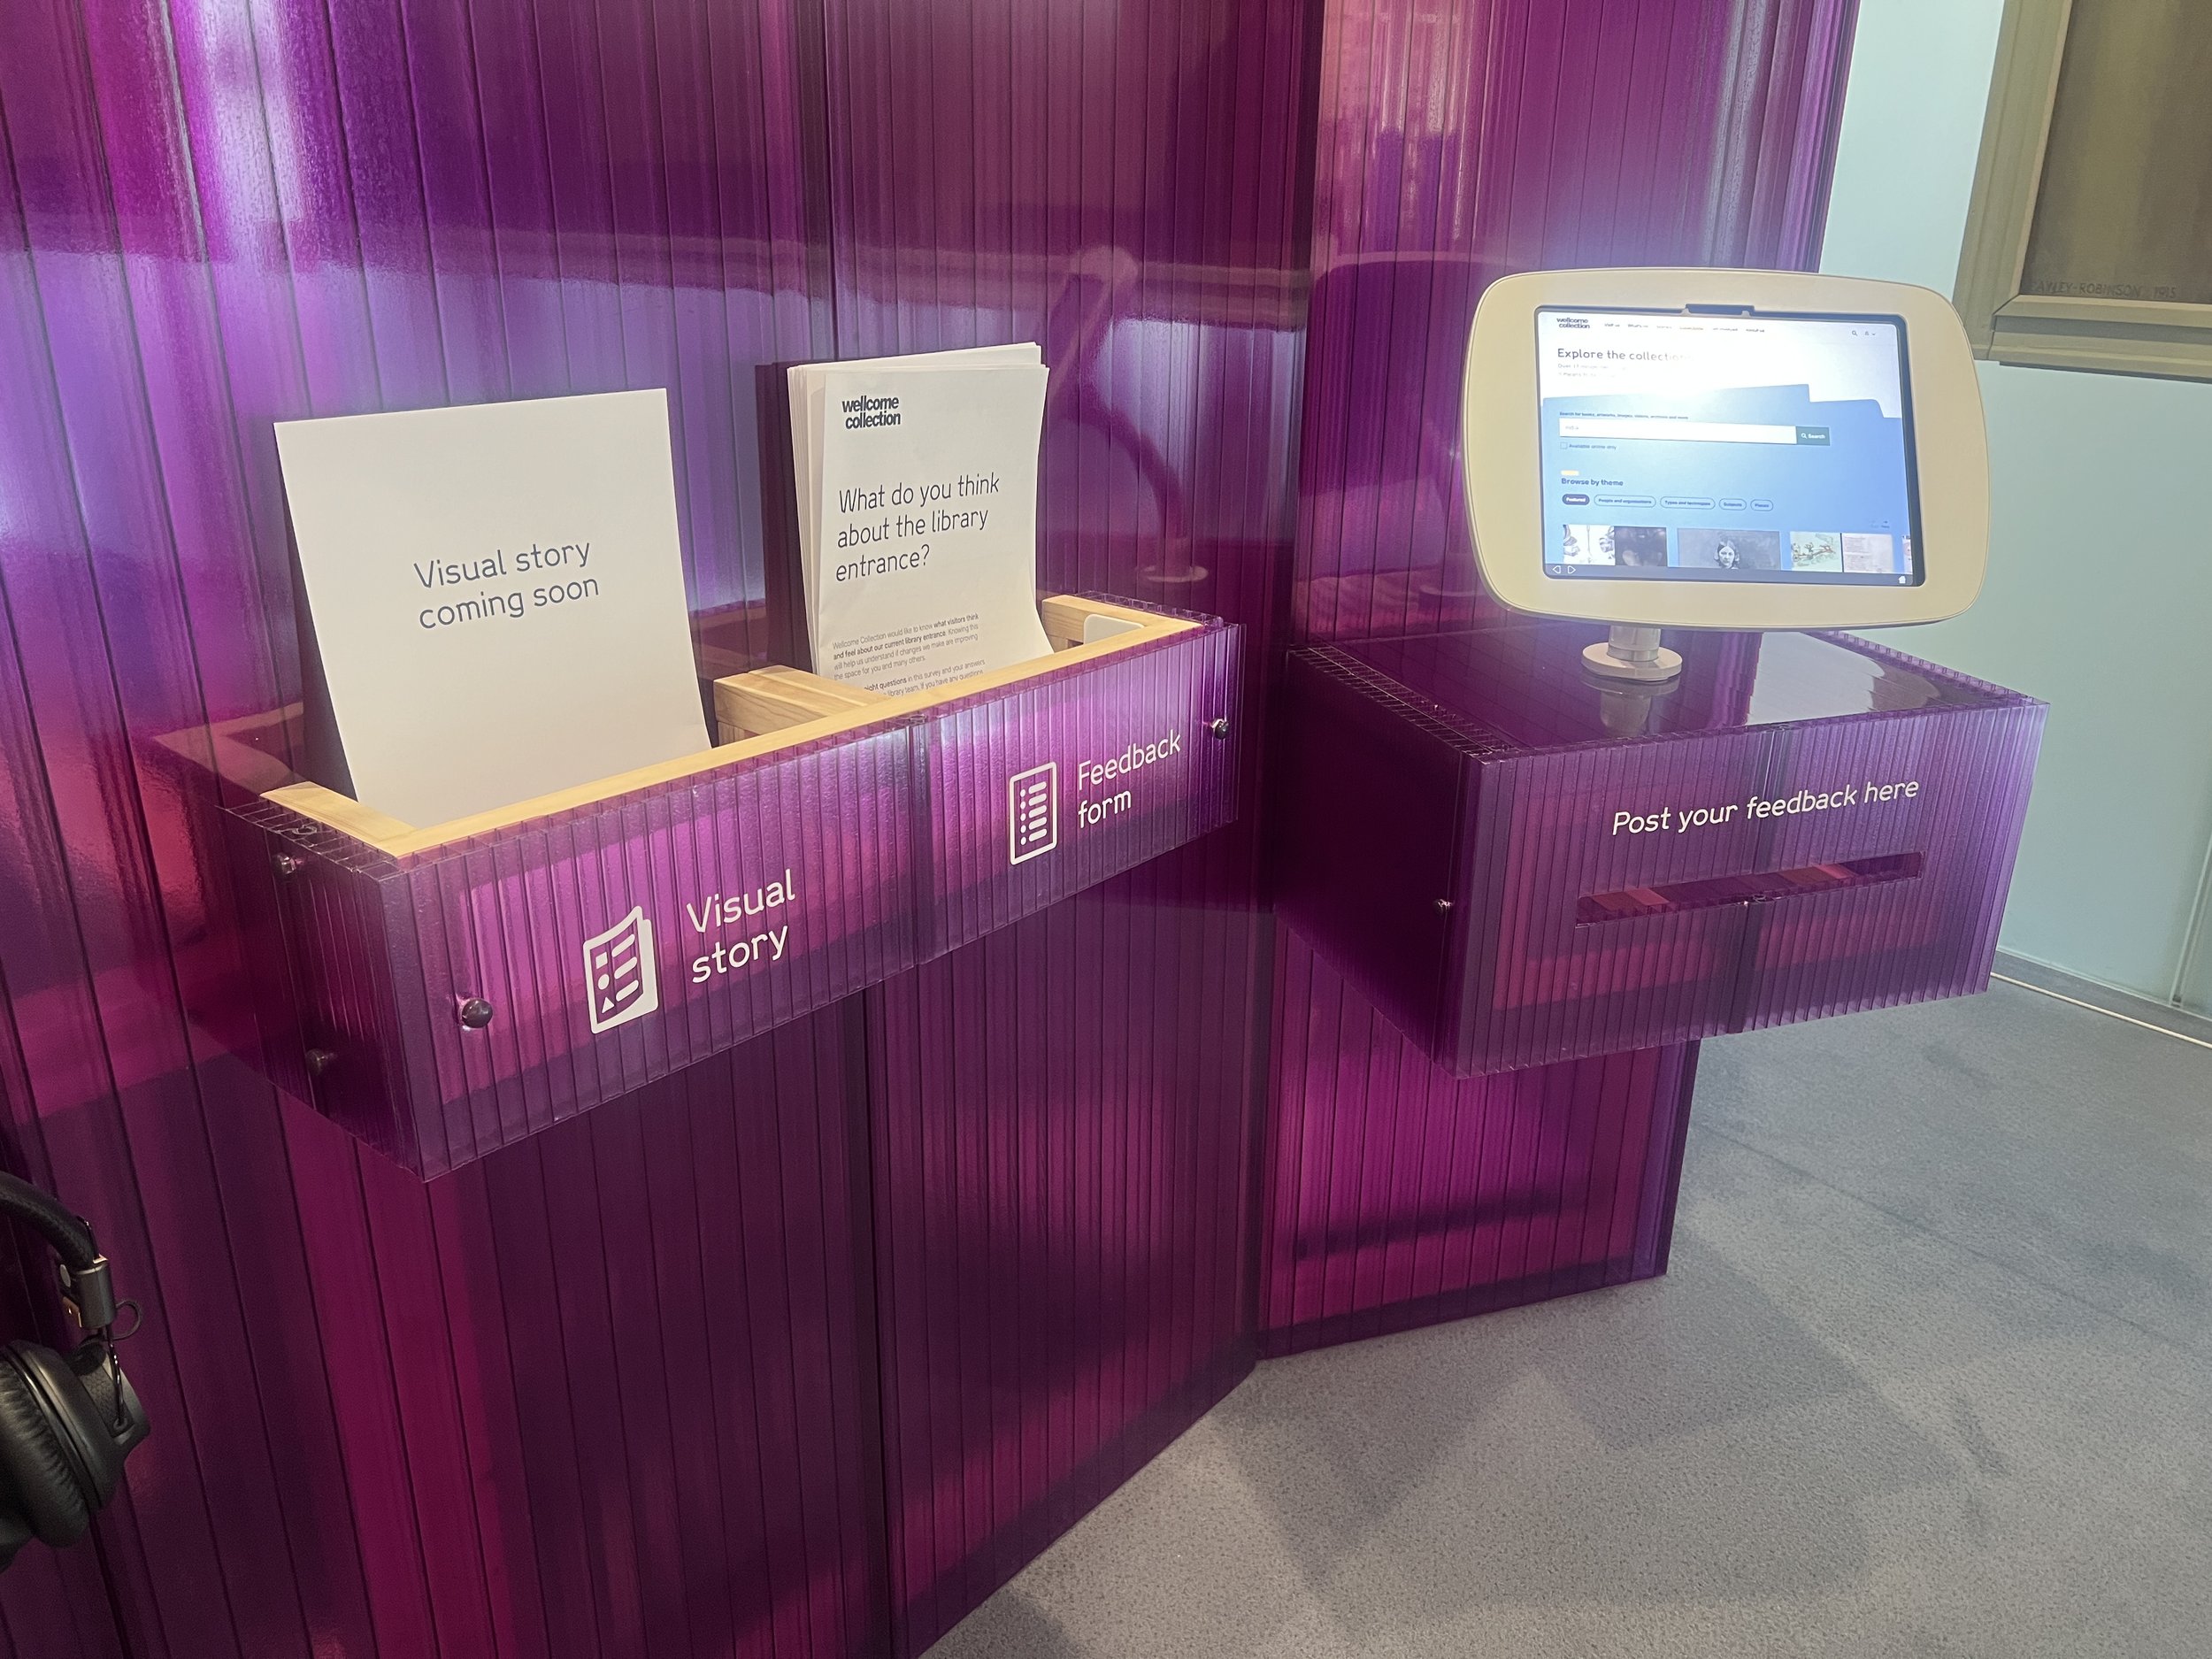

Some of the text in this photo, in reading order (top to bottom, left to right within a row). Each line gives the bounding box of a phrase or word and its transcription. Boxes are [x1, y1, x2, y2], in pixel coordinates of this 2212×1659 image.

[1557, 348, 1603, 361] Explore
[1607, 349, 1626, 361] the
[841, 396, 900, 412] wellcome
[845, 411, 902, 430] collection
[839, 472, 1000, 513] What do you think
[837, 509, 989, 549] about the library
[413, 542, 590, 588] Visual story
[835, 543, 930, 582] entrance?
[419, 578, 599, 629] coming soon
[833, 639, 859, 650] Wellcome
[860, 633, 887, 644] Collection
[887, 627, 903, 638] would
[947, 615, 966, 626] visitors
[966, 612, 979, 621] think
[833, 651, 844, 660] and
[845, 649, 856, 657] feel
[857, 645, 873, 656] about
[884, 639, 904, 649] current
[905, 635, 922, 645] library
[948, 625, 969, 635] Knowing
[843, 659, 856, 669] help
[864, 651, 894, 664] understand
[899, 644, 922, 657] changes
[955, 634, 979, 644] improving
[844, 669, 861, 680] space
[871, 665, 881, 674] you
[882, 661, 893, 671] and
[879, 678, 907, 689] questions
[924, 670, 941, 679] survey
[952, 664, 964, 672] your
[964, 659, 986, 669] answers
[887, 687, 903, 696] library
[1079, 729, 1181, 790] Feedback
[1078, 790, 1132, 828] form
[1612, 780, 1919, 836] Post your feedback here
[686, 868, 795, 933] Visual
[692, 925, 787, 983] story
